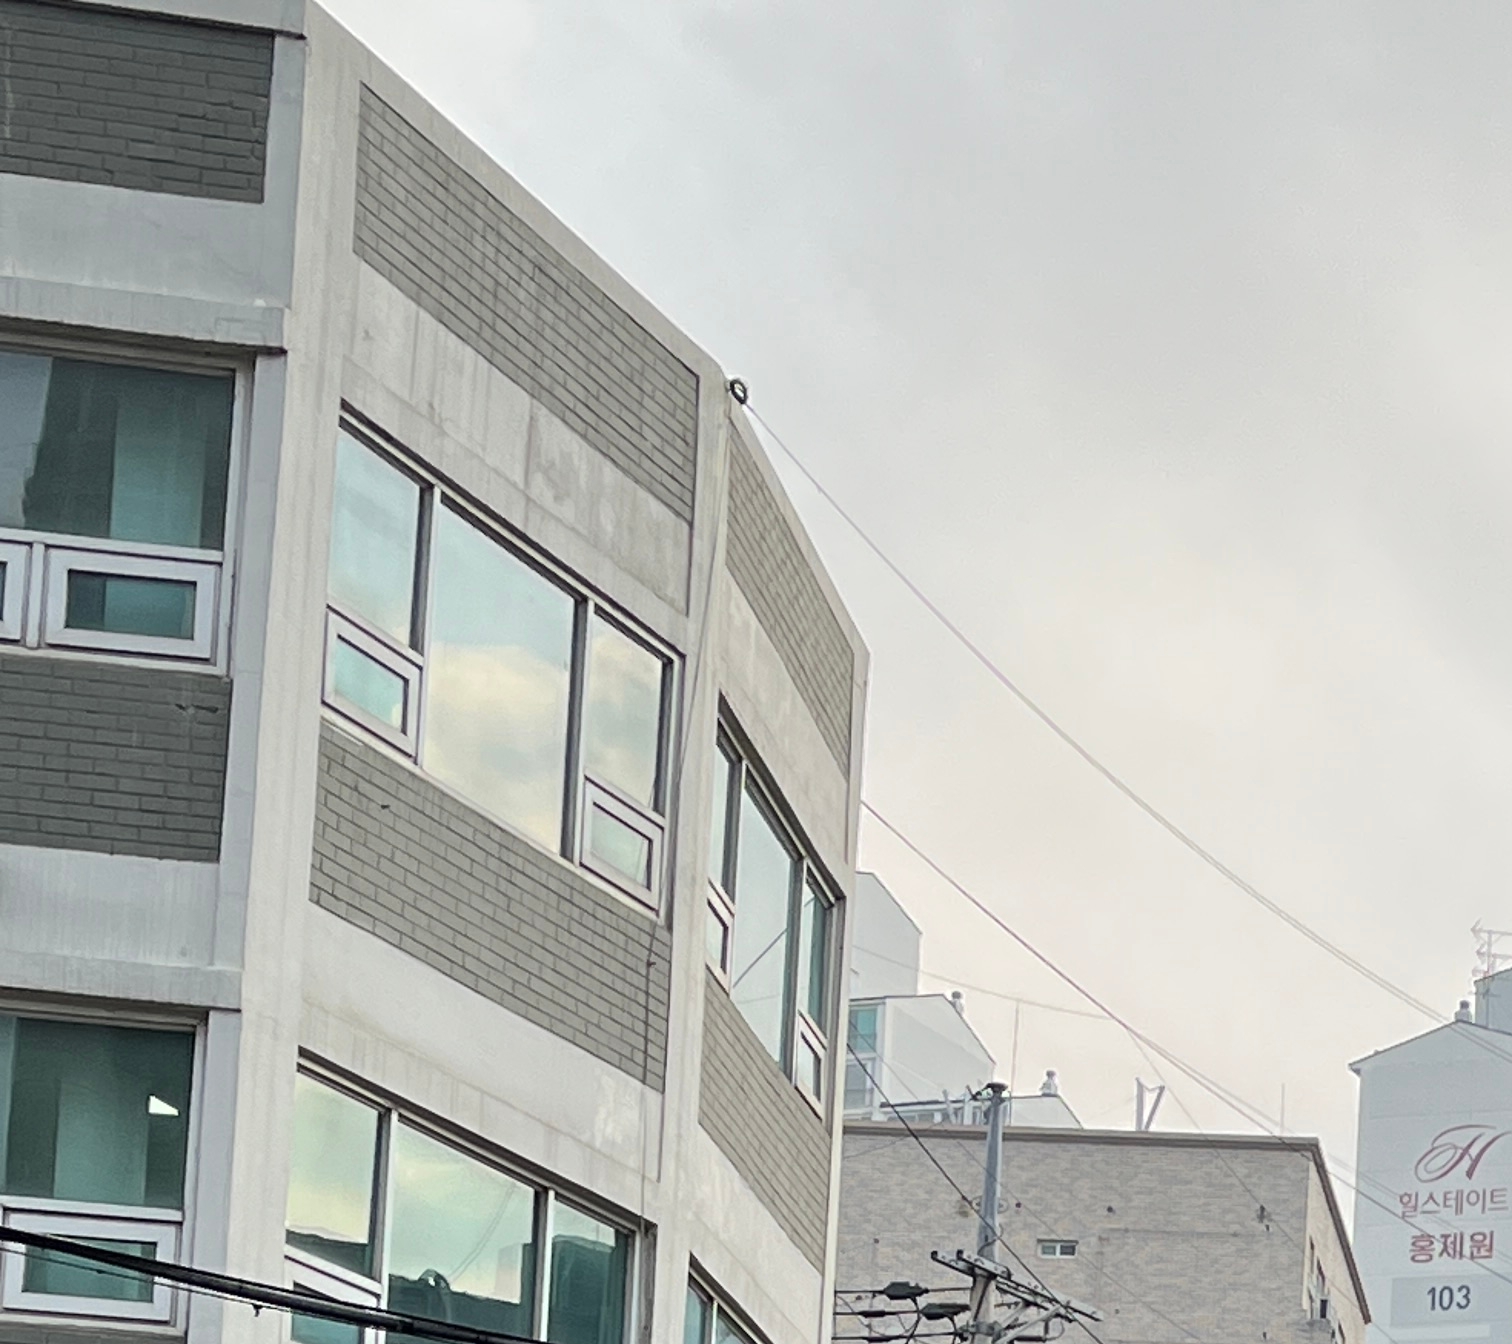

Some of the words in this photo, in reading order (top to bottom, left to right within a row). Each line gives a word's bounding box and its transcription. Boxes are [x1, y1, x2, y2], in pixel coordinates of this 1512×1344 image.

[1399, 1187, 1510, 1219] 힐스테이트
[1408, 1229, 1495, 1264] 홍제원
[1426, 1284, 1472, 1312] 103
